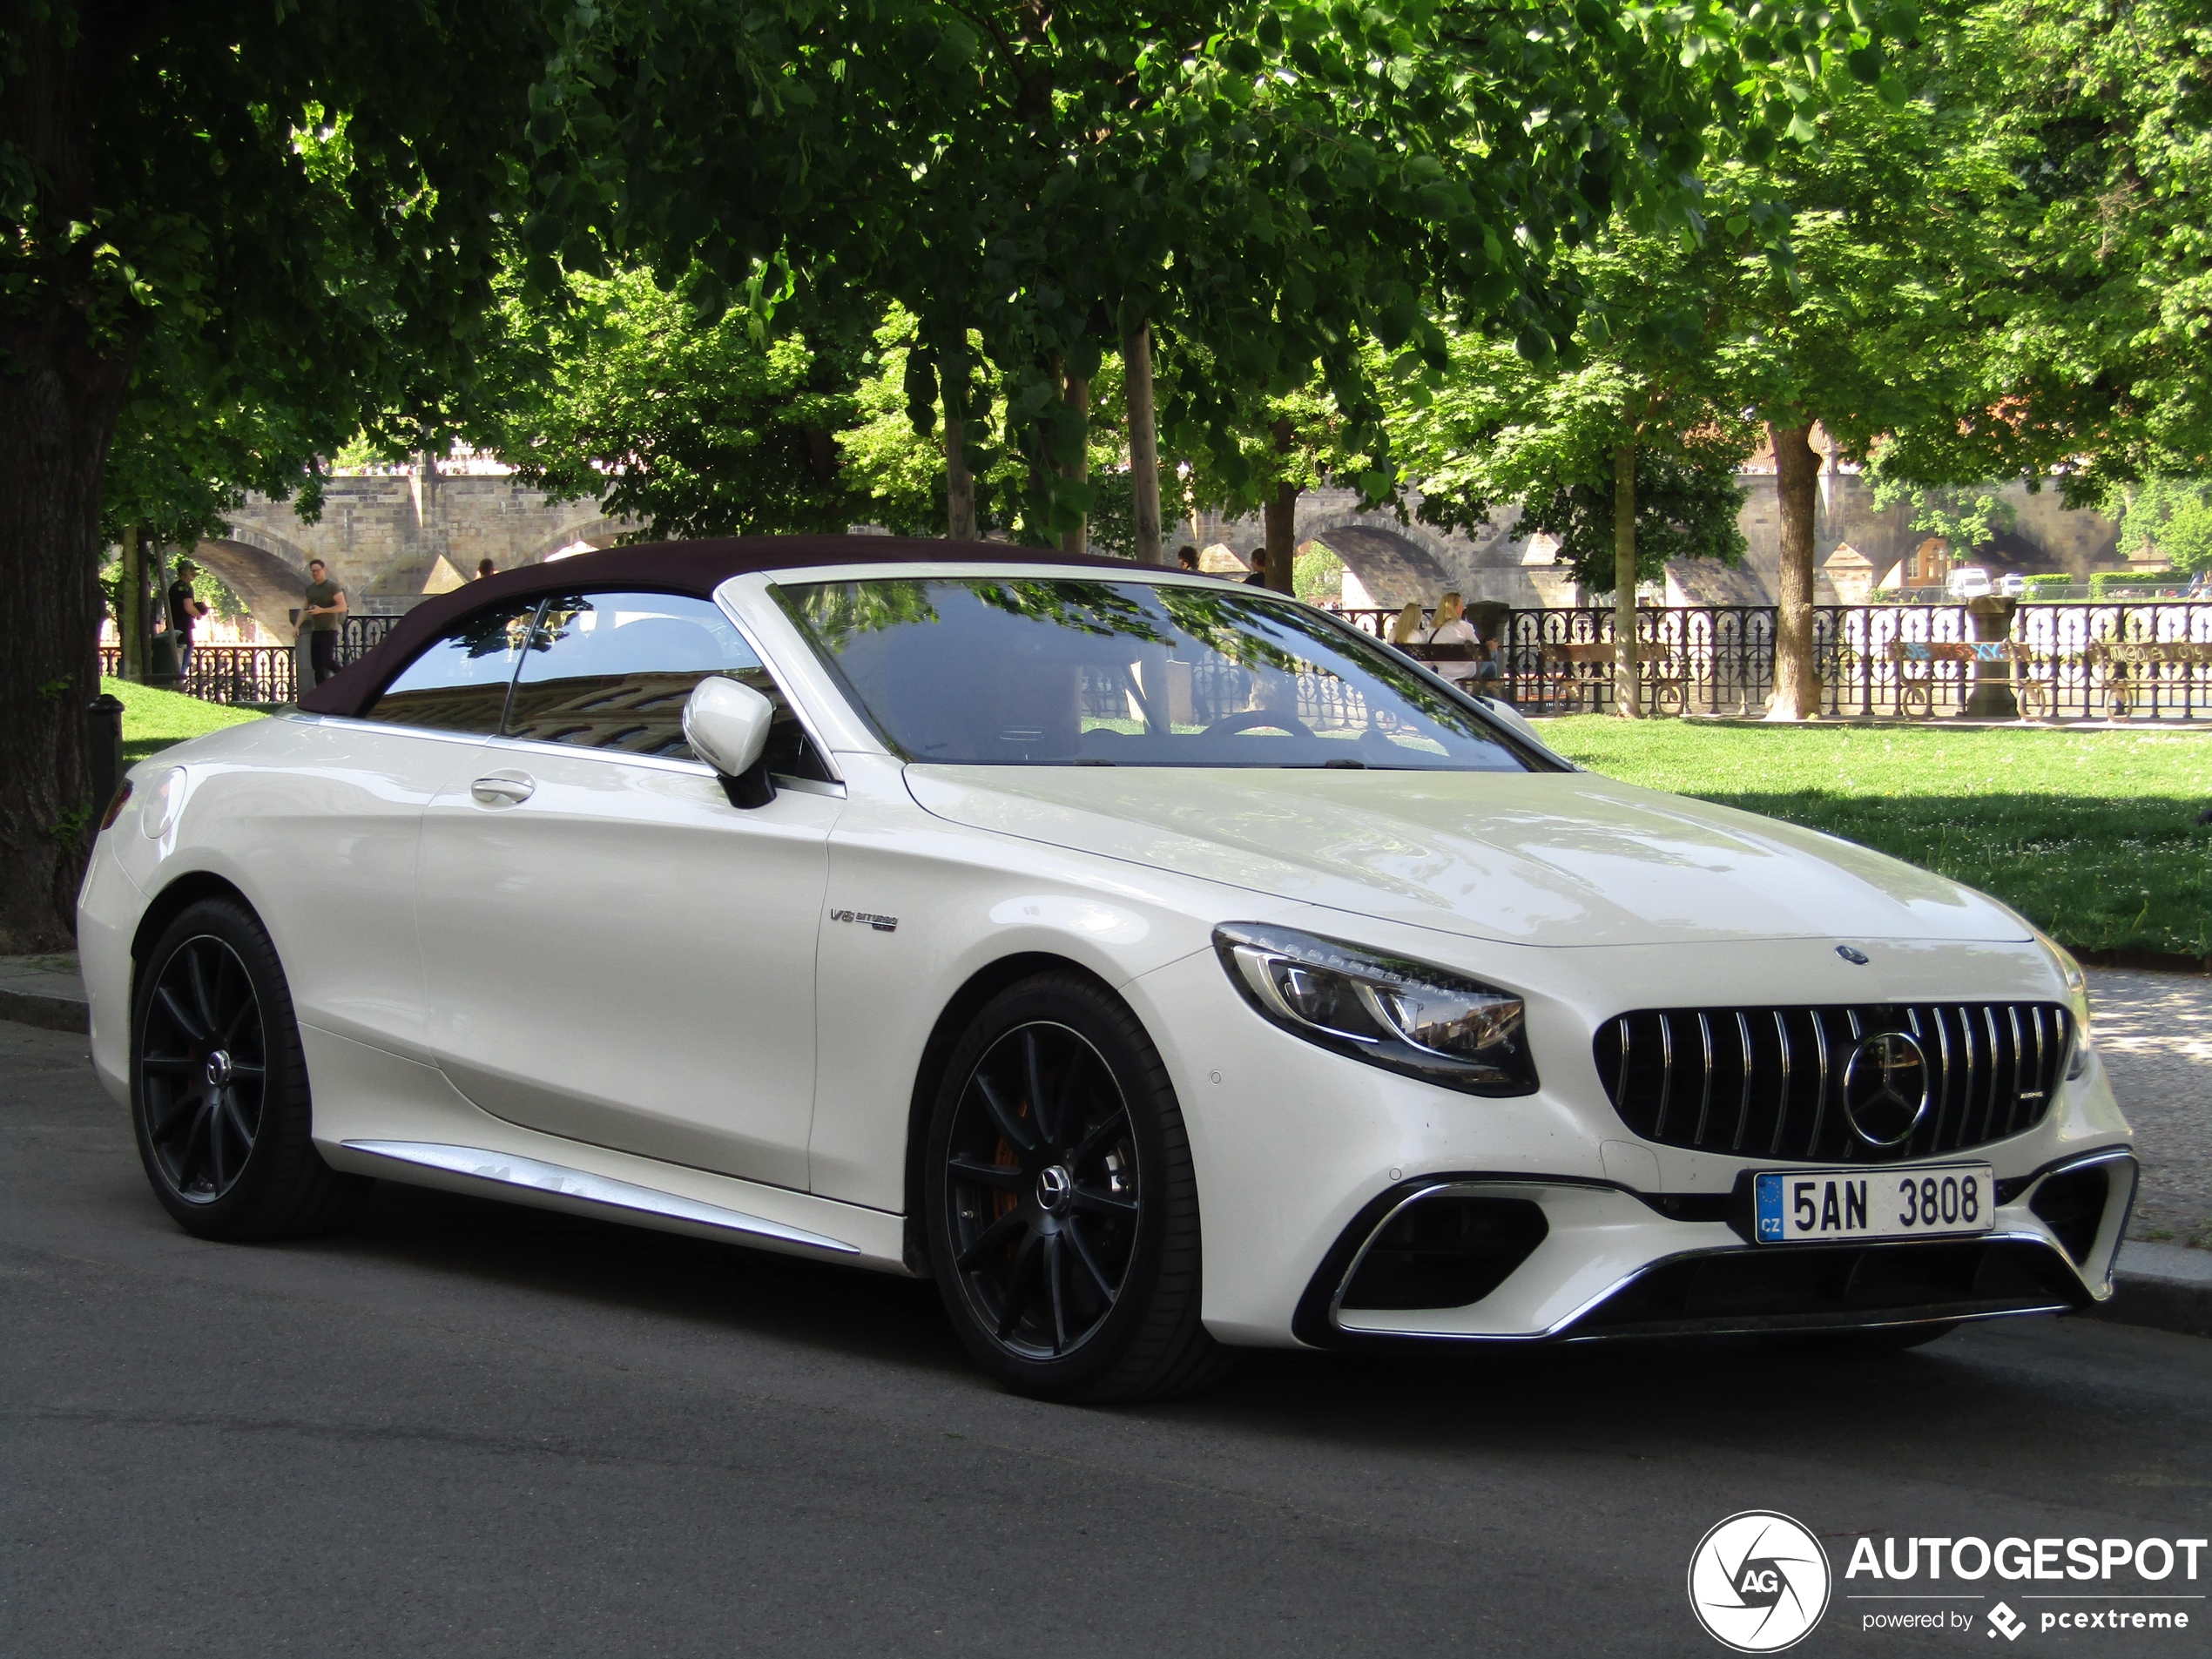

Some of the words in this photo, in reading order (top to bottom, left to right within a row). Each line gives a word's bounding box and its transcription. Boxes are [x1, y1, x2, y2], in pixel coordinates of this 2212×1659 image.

[831, 908, 854, 922] V8
[855, 912, 898, 925] BITURBO
[1792, 1180, 1867, 1231] 5AN
[1898, 1175, 1979, 1227] 3808
[1761, 1218, 1780, 1232] CZ
